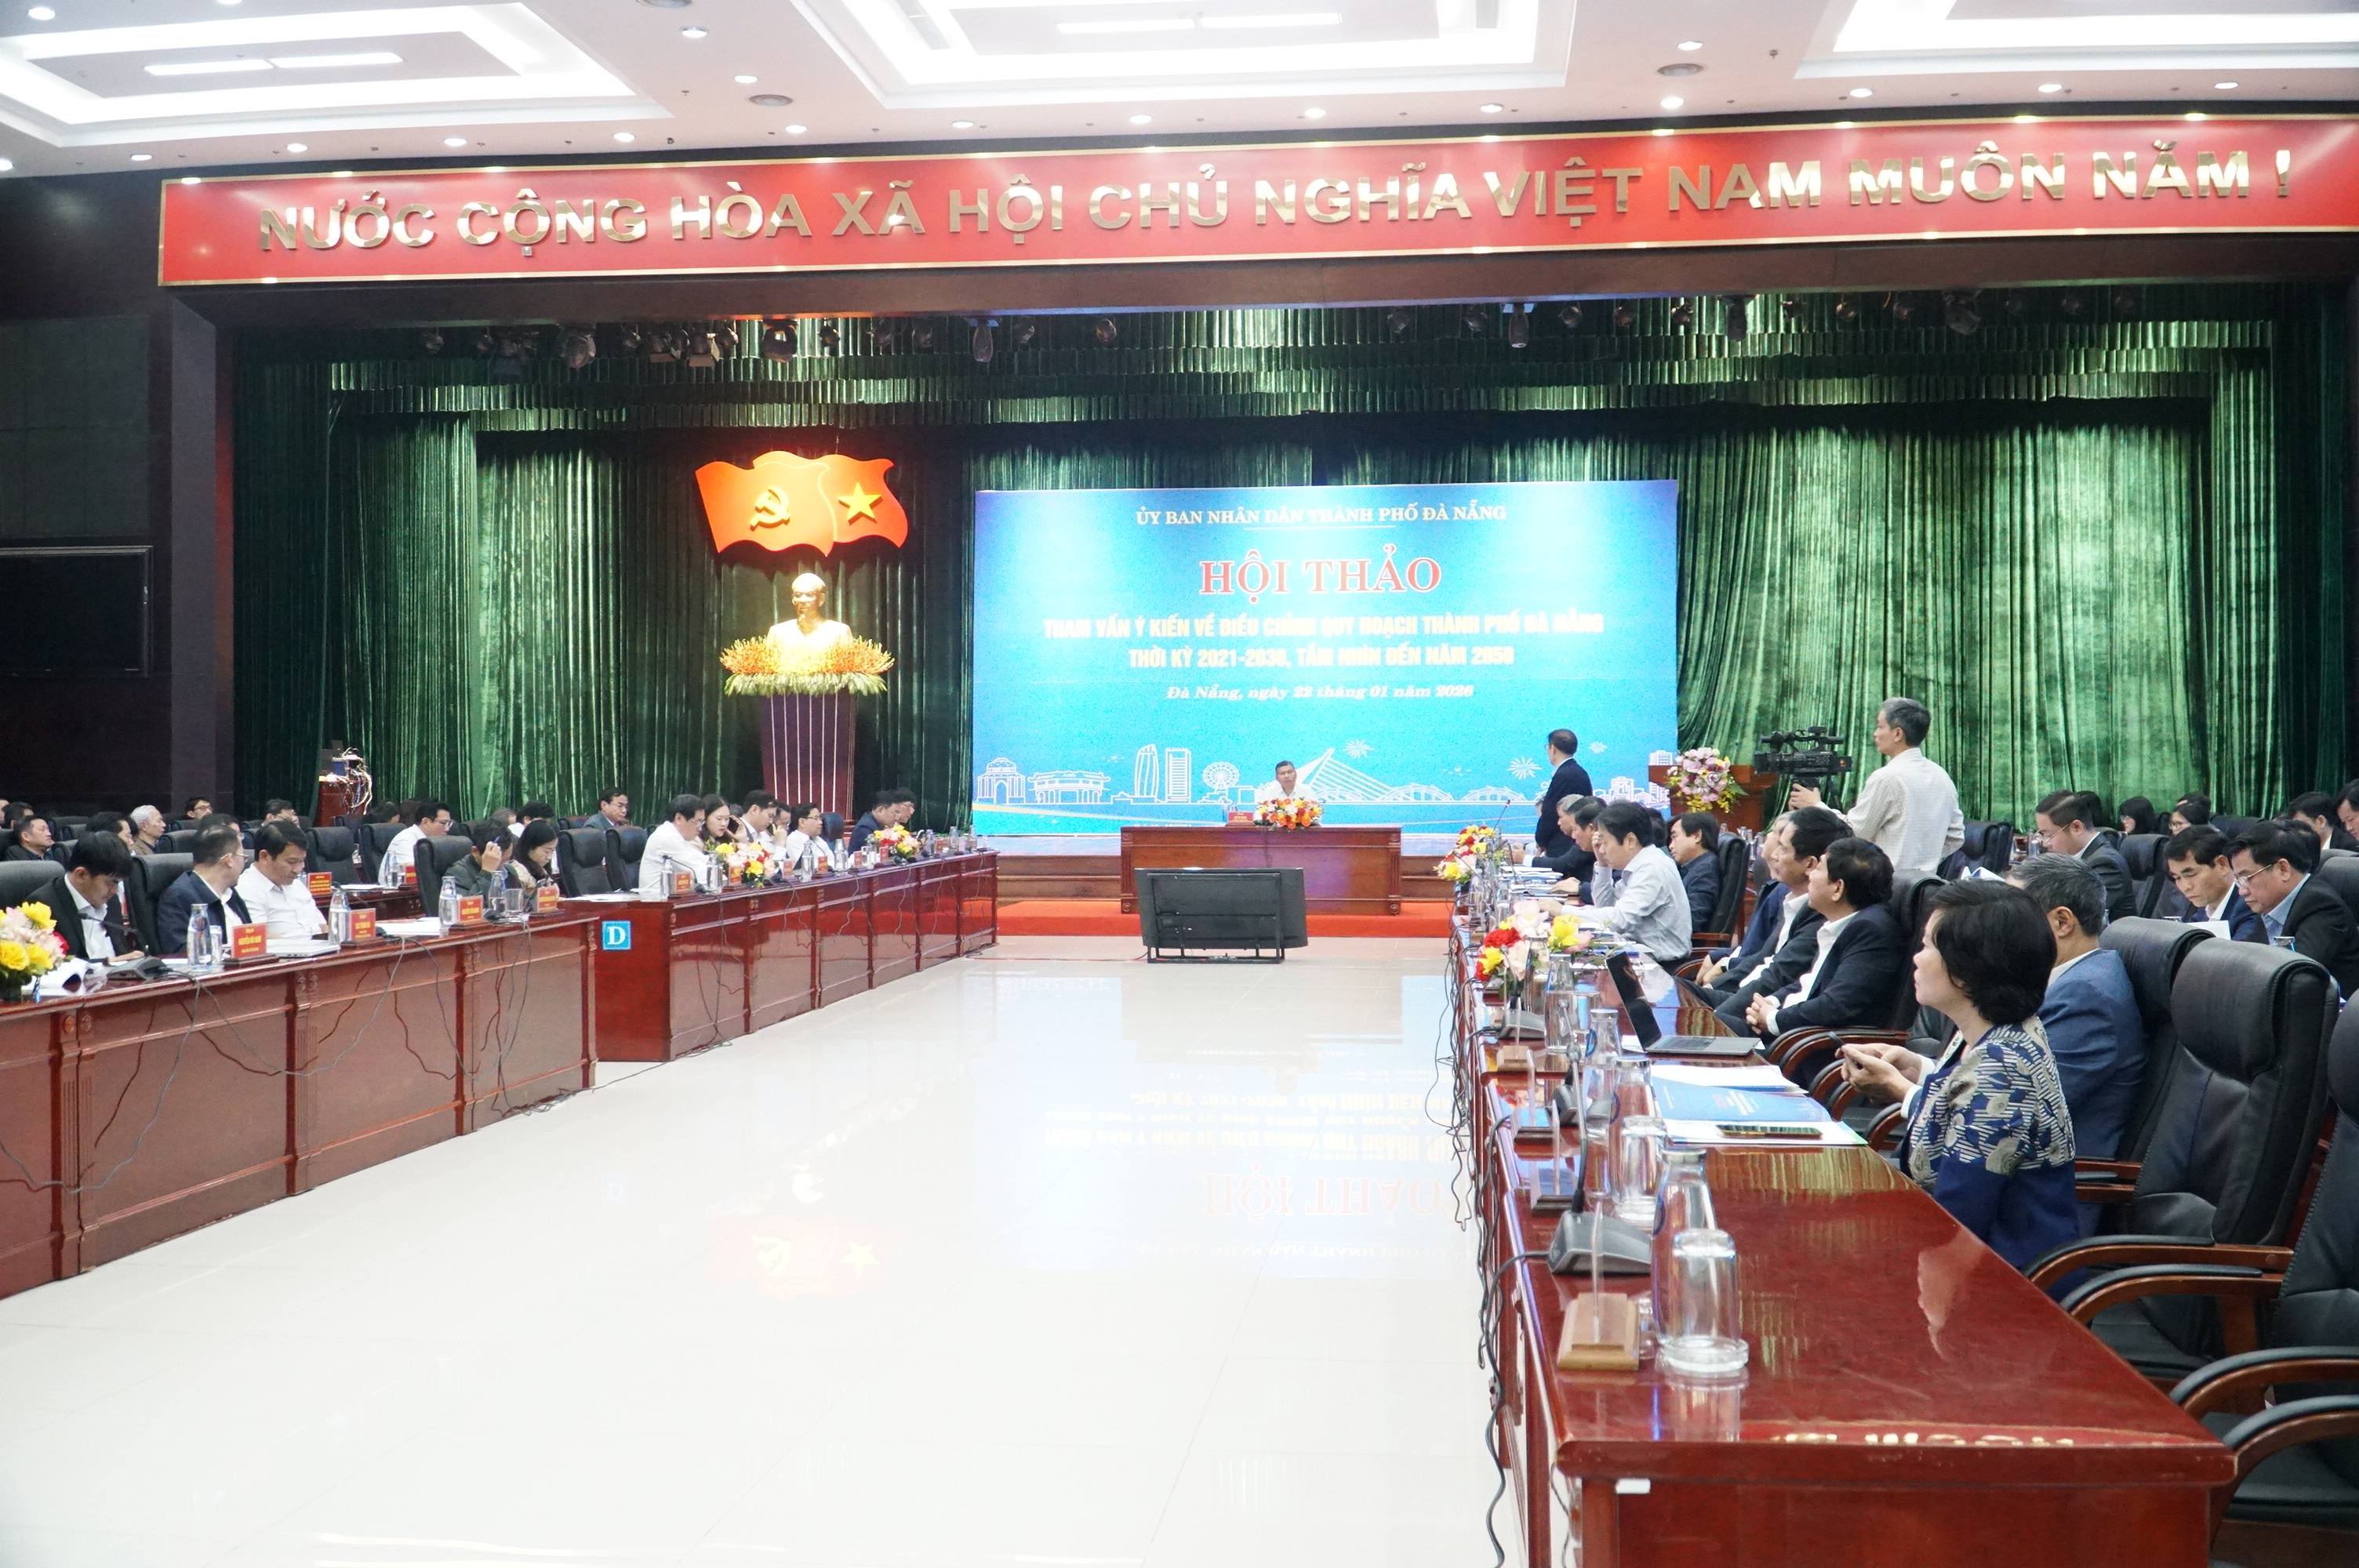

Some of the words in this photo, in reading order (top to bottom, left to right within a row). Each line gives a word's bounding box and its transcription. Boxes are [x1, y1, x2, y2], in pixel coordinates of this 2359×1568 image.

[260, 190, 434, 251] NƯỚC
[457, 188, 647, 256] CỘNG
[671, 182, 812, 240] HÒA
[832, 180, 925, 236] XÃ
[949, 173, 1063, 245] HỘI
[1089, 164, 1229, 230] CHỦ
[1256, 162, 1474, 226] NGHĨA
[1483, 158, 1642, 227] VIỆT
[1668, 160, 1822, 212] NAM
[1849, 140, 2066, 206] MUÔN
[2093, 140, 2249, 199] NĂM
[1136, 506, 1161, 525] ỦY
[1165, 510, 1202, 524] BAN
[1207, 506, 1259, 524] NHÂN
[1263, 505, 1303, 523] DÂN
[1307, 504, 1373, 523] THÀNH
[1378, 502, 1419, 521] PHỐ
[1422, 504, 1449, 521] ĐÀ
[1453, 499, 1507, 521] NẴNG
[1199, 550, 1290, 604] HỘI
[1303, 543, 1441, 593] THẢO
[1043, 619, 1091, 638] THAM
[1096, 613, 1130, 637] VẤN
[1135, 615, 1145, 637] Ý
[1150, 613, 1190, 637] KIẾN
[1194, 612, 1215, 637] VỀ
[1321, 617, 1355, 637] QUY
[1359, 616, 1418, 639] HOẠCH
[1423, 612, 1480, 634] THÀNH
[1484, 608, 1521, 633] PHỐ
[1129, 645, 1166, 667] THỜI
[1171, 645, 1192, 667] KỲ
[1197, 648, 1291, 669] 2021-2030,
[1338, 644, 1381, 666] NHÌN
[1385, 641, 1421, 666] ĐẾN
[1426, 643, 1467, 665] NĂM
[1471, 646, 1514, 665] 2050
[1166, 686, 1190, 699] Đà
[1194, 684, 1243, 701] Nẵng,
[1247, 687, 1289, 701] ngày
[1292, 686, 1313, 698] 22
[1317, 685, 1367, 700] tháng
[1369, 685, 1388, 697] 01
[1394, 687, 1431, 698] năm
[1435, 685, 1474, 697] 2026
[607, 926, 626, 945] D
